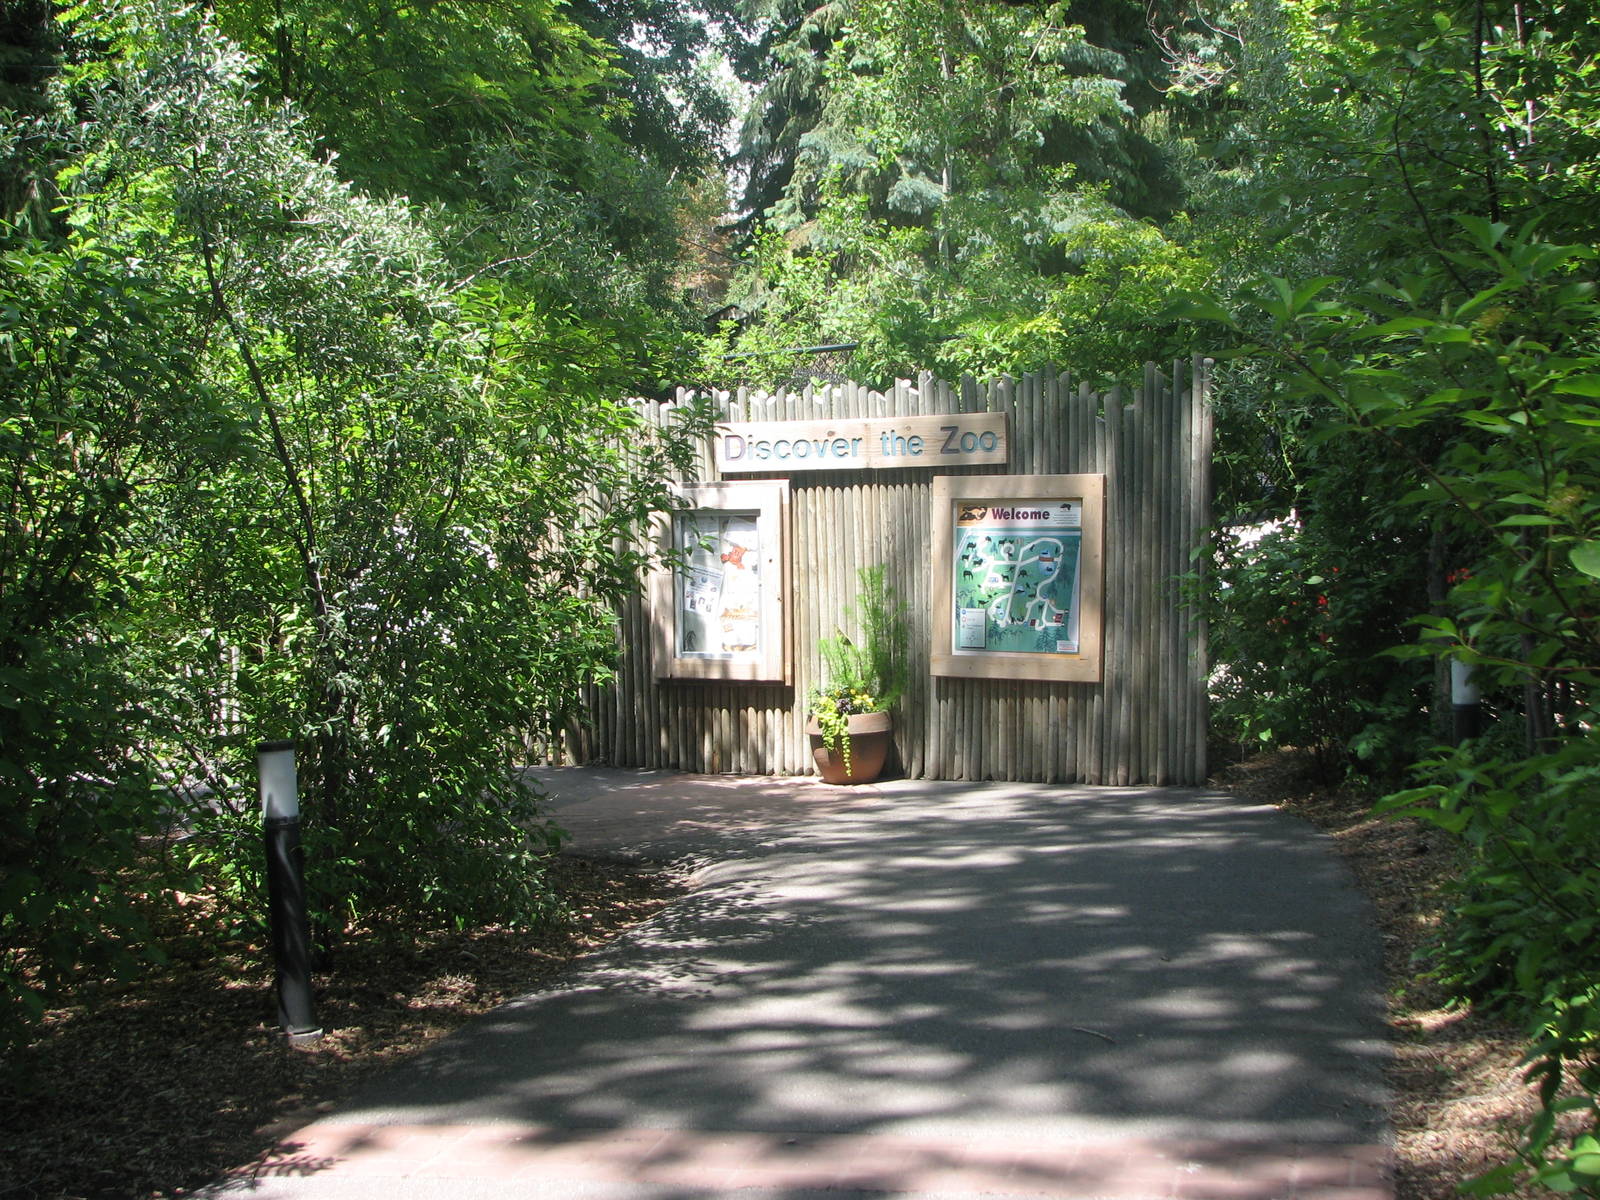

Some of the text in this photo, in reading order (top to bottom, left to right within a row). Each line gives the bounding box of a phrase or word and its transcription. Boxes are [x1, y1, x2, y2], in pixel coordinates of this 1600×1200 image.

[724, 425, 998, 461] Discover the Zoo
[992, 508, 1050, 520] Welcome
